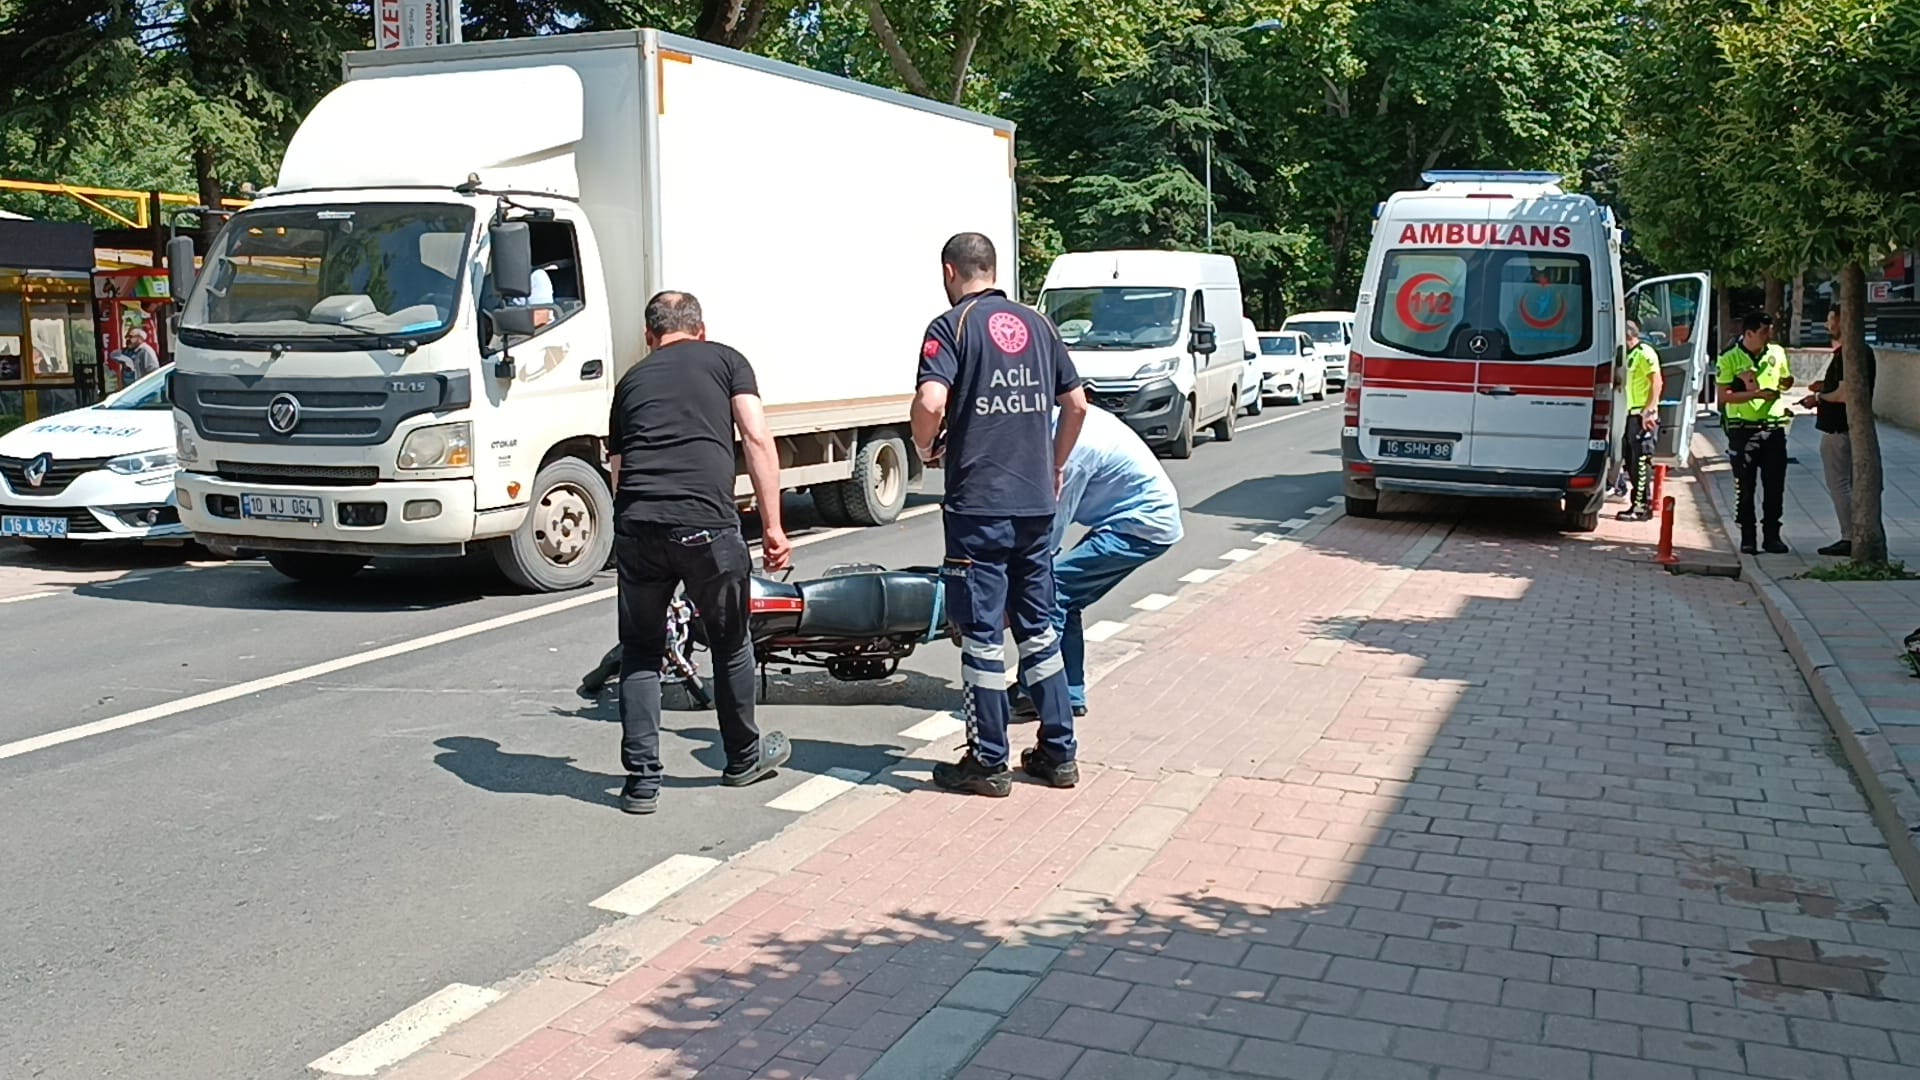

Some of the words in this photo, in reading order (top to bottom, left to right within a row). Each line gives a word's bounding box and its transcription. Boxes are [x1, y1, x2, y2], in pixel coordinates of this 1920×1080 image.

[1398, 223, 1571, 248] AMBULANS
[1410, 292, 1453, 314] 112
[990, 364, 1040, 388] ACİL
[1404, 442, 1431, 455] SHH
[10, 519, 22, 532] 16
